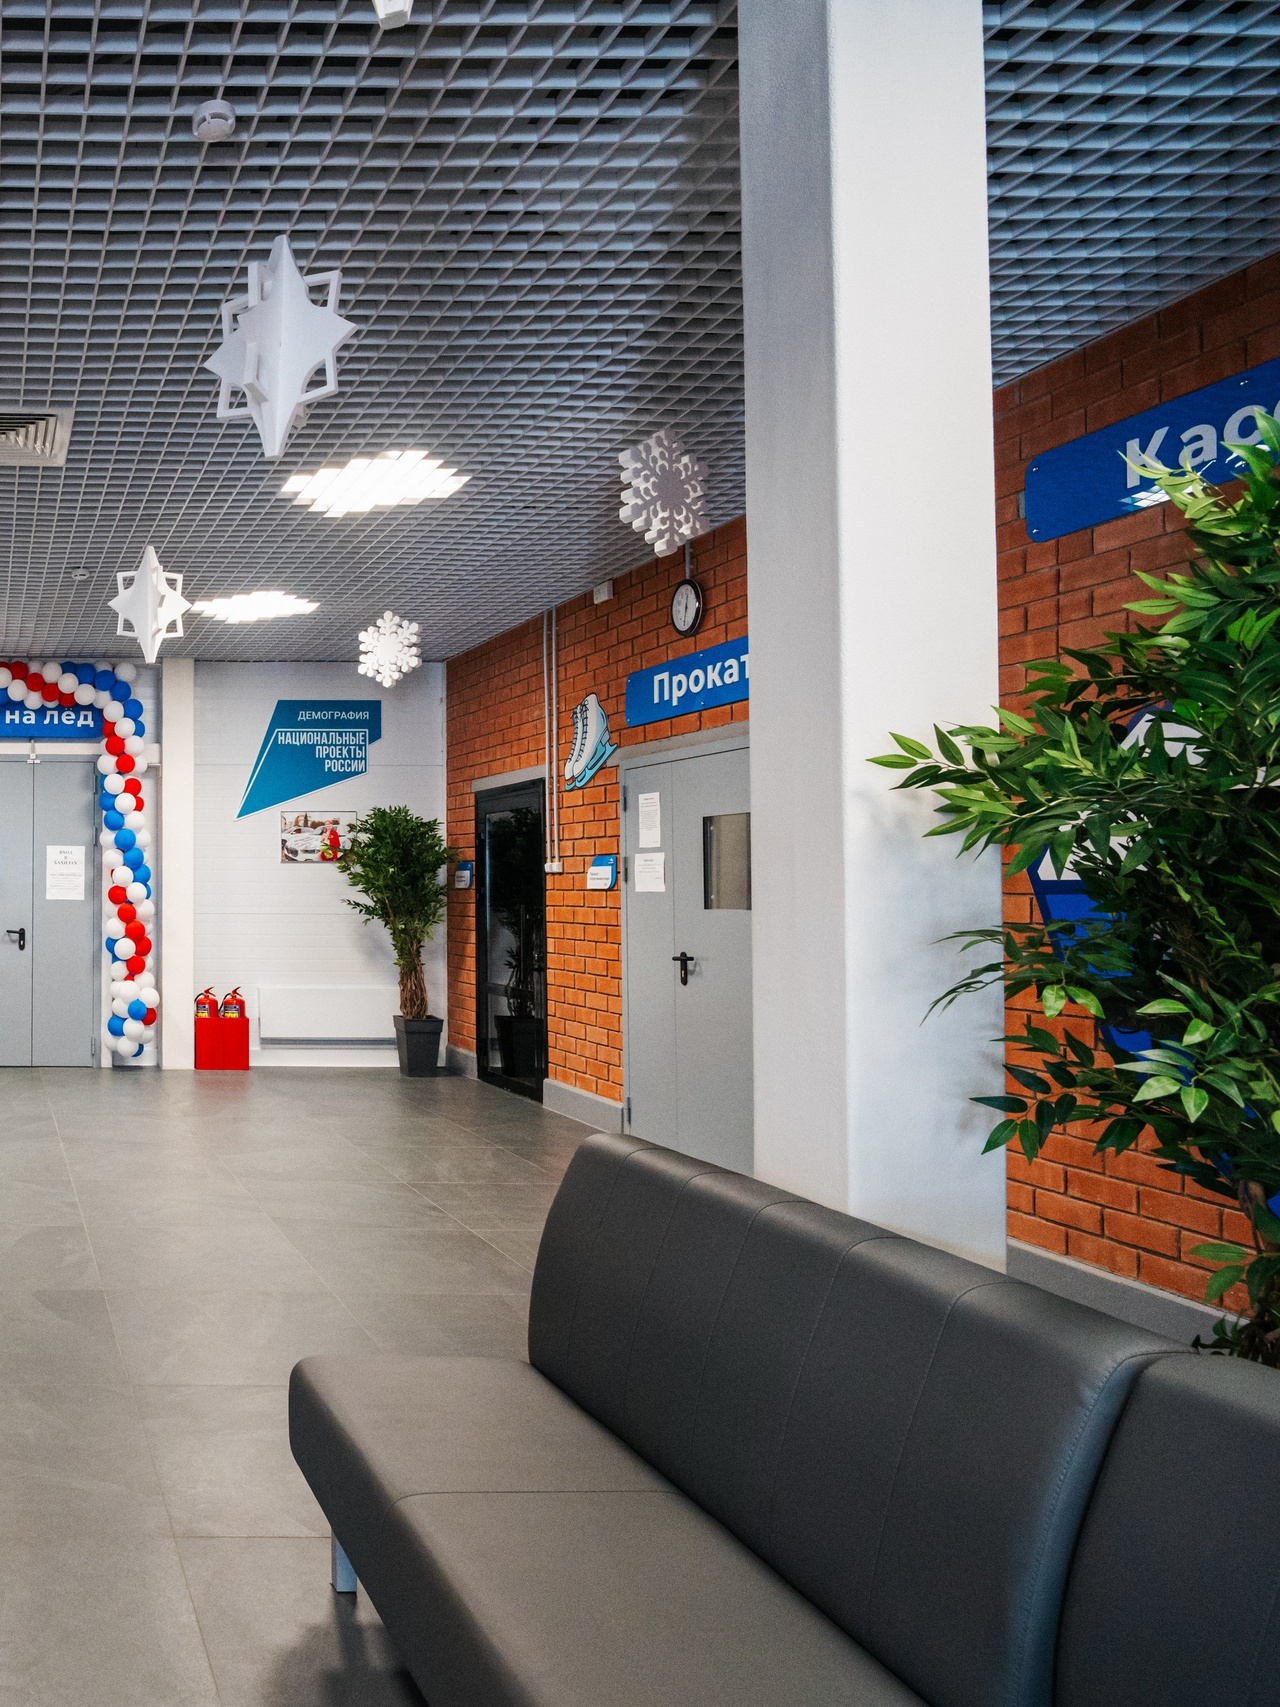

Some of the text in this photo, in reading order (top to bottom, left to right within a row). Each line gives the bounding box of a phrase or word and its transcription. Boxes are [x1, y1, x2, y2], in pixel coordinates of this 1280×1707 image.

[1126, 399, 1280, 489] Кас
[5, 709, 36, 725] на
[43, 707, 94, 728] лёд
[297, 711, 370, 721] ДЕМОГРАФИЯ
[277, 731, 366, 746] НАЦИОНАЛЬНЫЕ
[315, 745, 366, 759] ПРОЕКТЫ
[324, 759, 366, 772] РОССИИ
